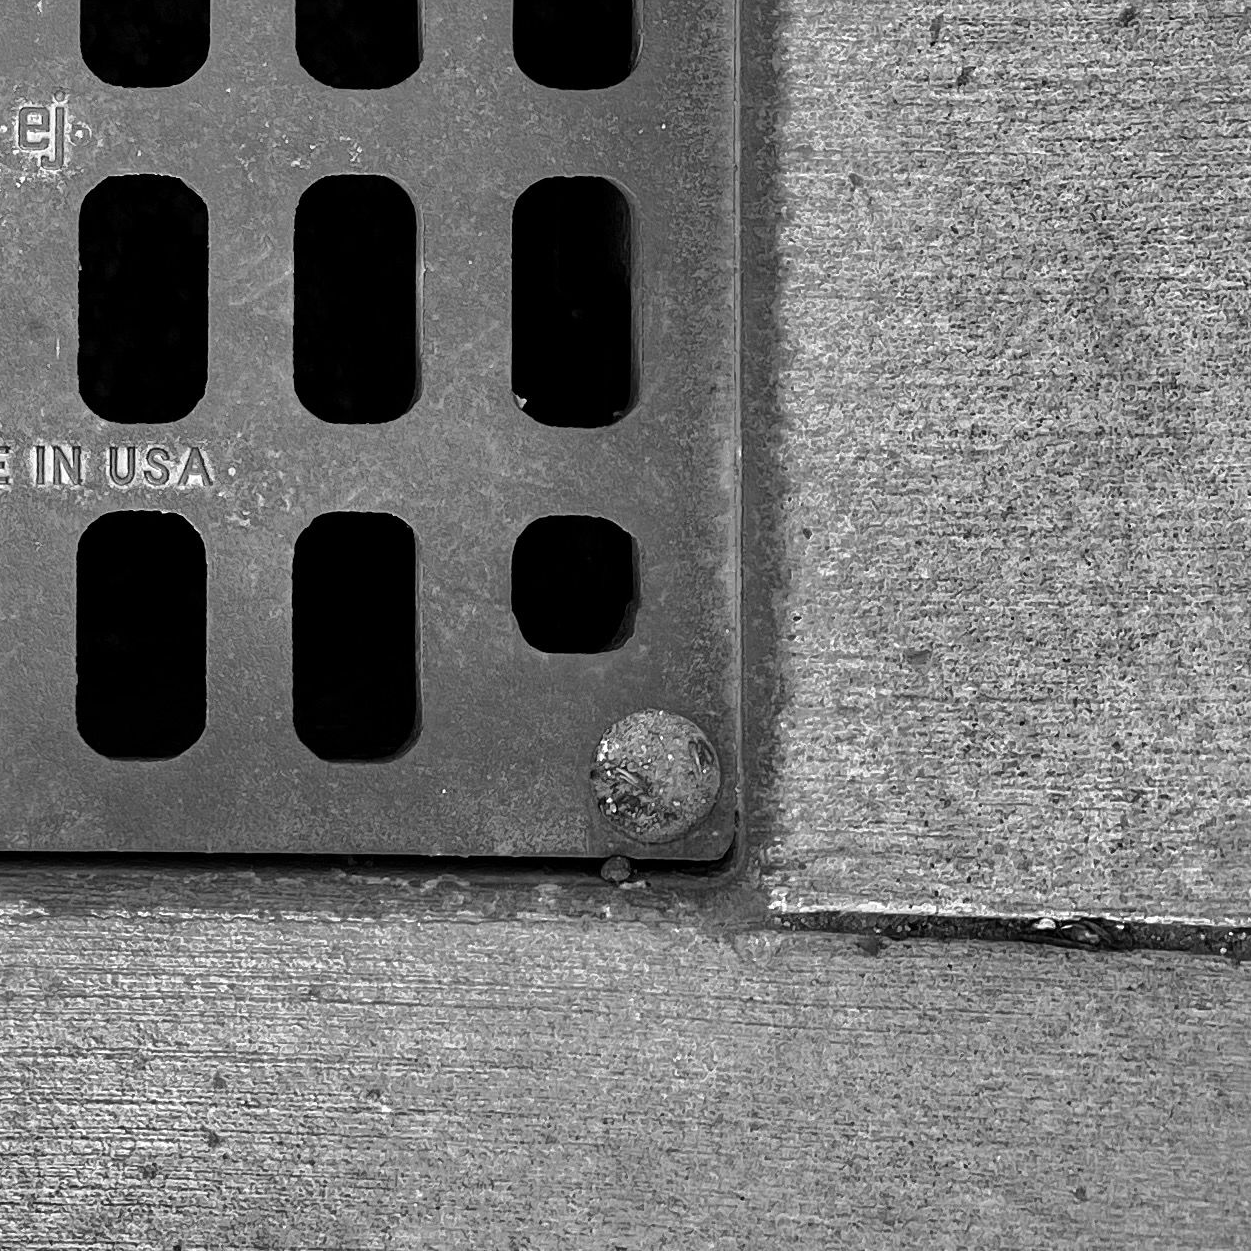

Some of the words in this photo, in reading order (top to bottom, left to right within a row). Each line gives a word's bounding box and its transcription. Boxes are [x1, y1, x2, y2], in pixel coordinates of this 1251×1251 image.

[18, 89, 65, 169] ej
[36, 445, 84, 487] IN
[109, 446, 213, 488] USA
